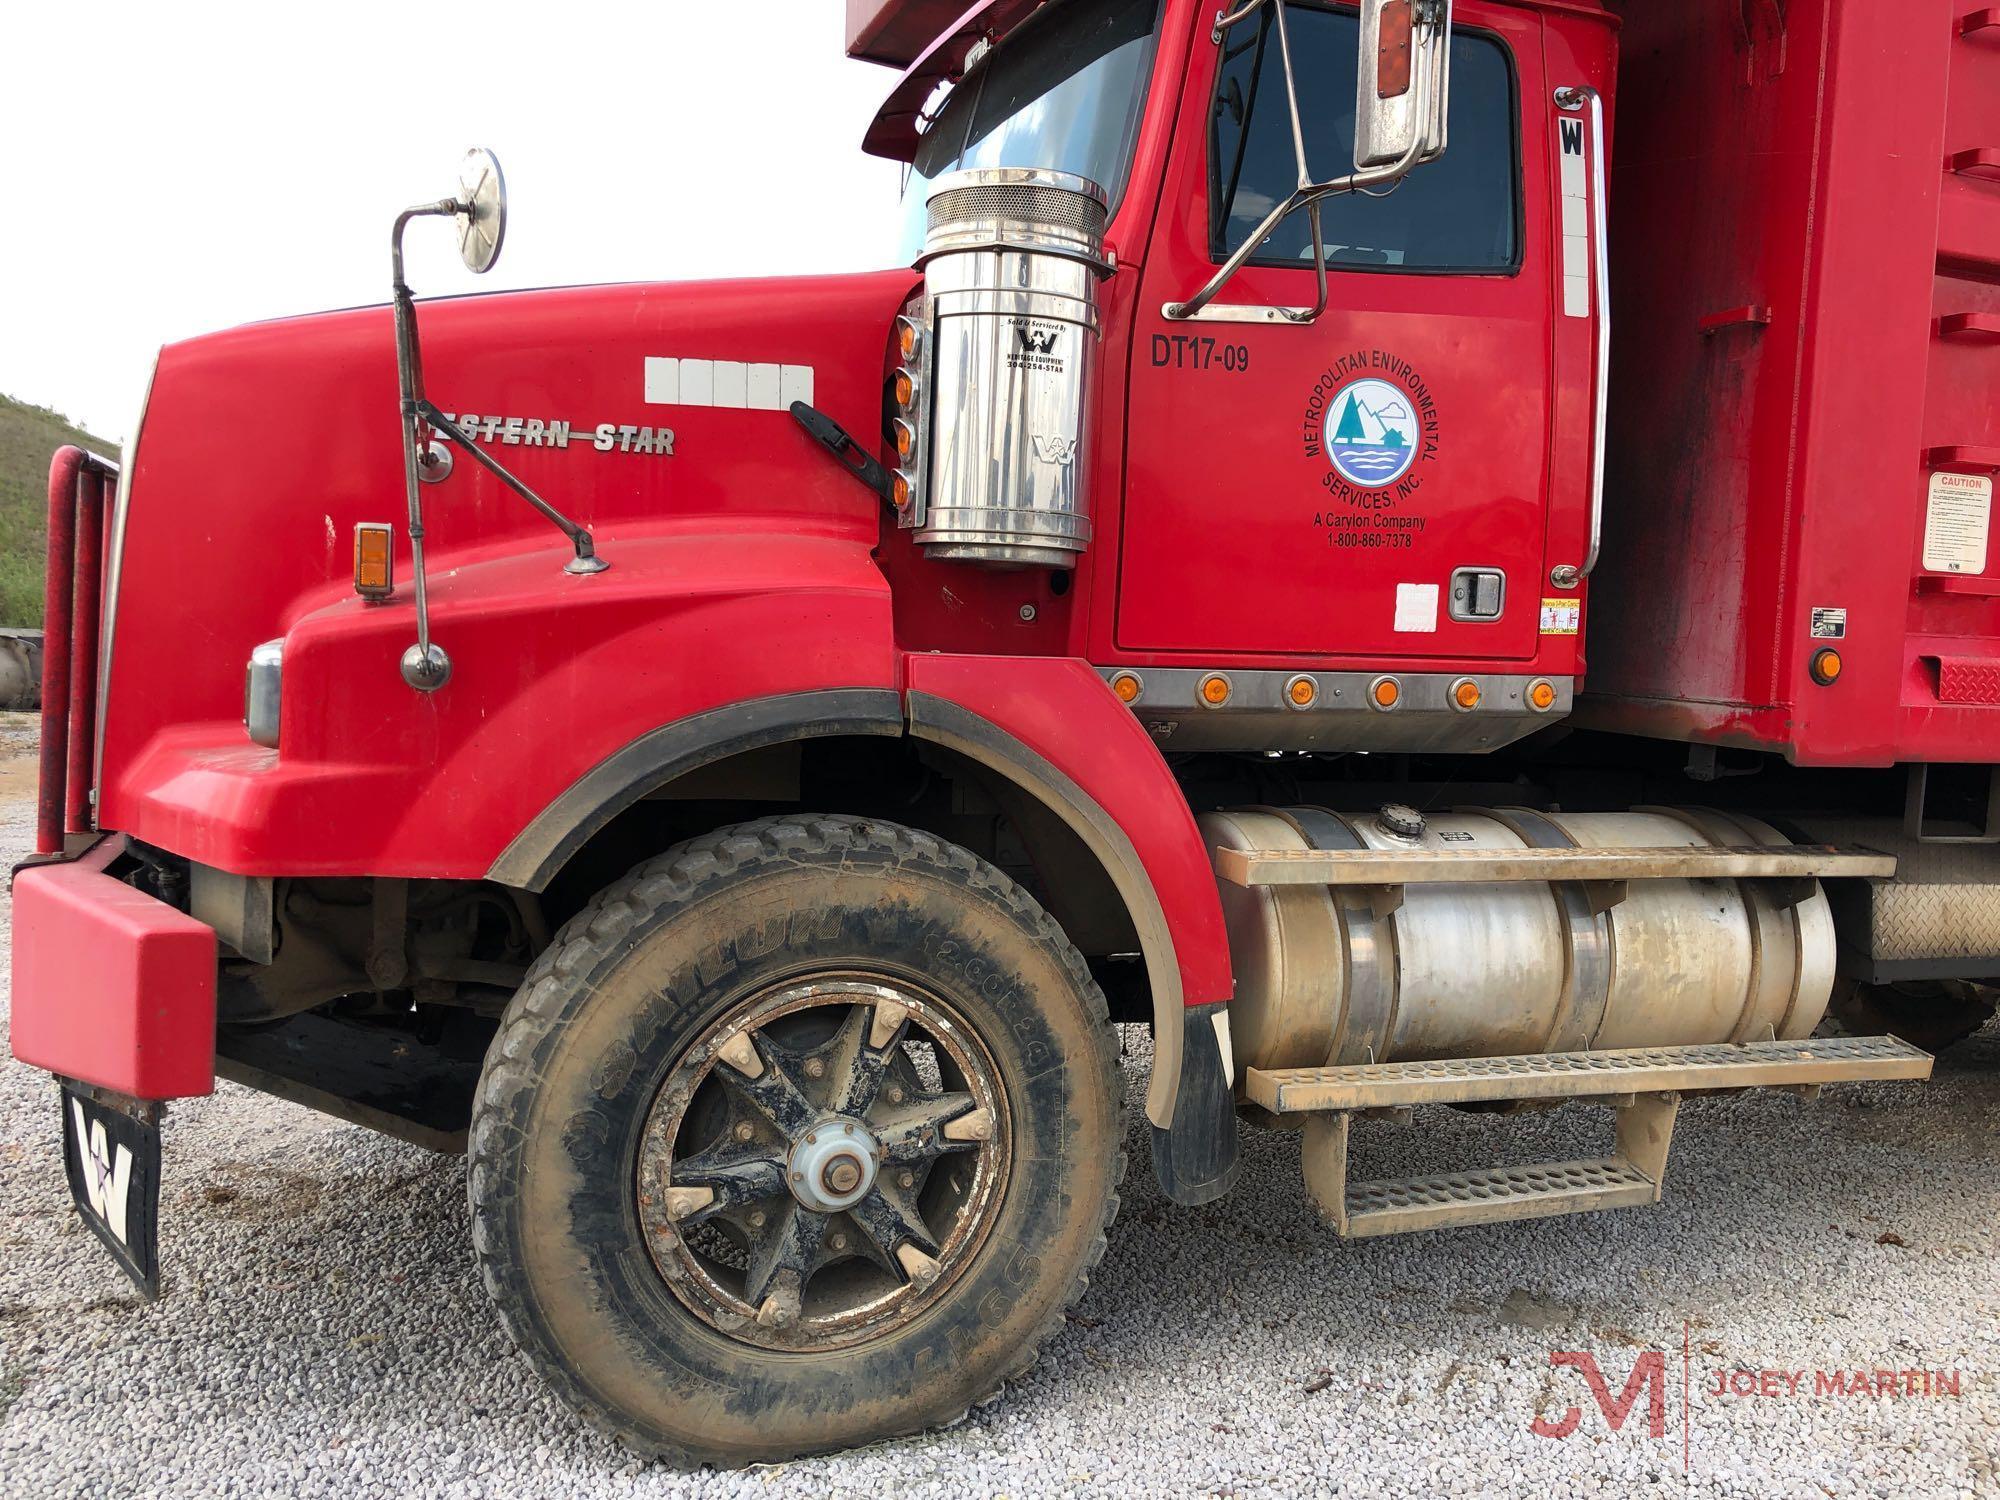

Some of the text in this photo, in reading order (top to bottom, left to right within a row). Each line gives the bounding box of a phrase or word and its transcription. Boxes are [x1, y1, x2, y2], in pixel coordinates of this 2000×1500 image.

[1560, 119, 1582, 155] W
[1008, 319, 1023, 327] Sold
[1032, 320, 1059, 330] Serviced
[1152, 333, 1249, 372] DT17-09
[1304, 350, 1439, 462] METROPOLITAN ENVIRONMENTAL
[415, 412, 676, 456] STERN STAR
[1322, 471, 1424, 509] SERVICES, INC.
[1941, 476, 1982, 489] CAUTION
[1312, 512, 1426, 532] A Carylon Company
[1328, 532, 1412, 548] 1-800-860-7378
